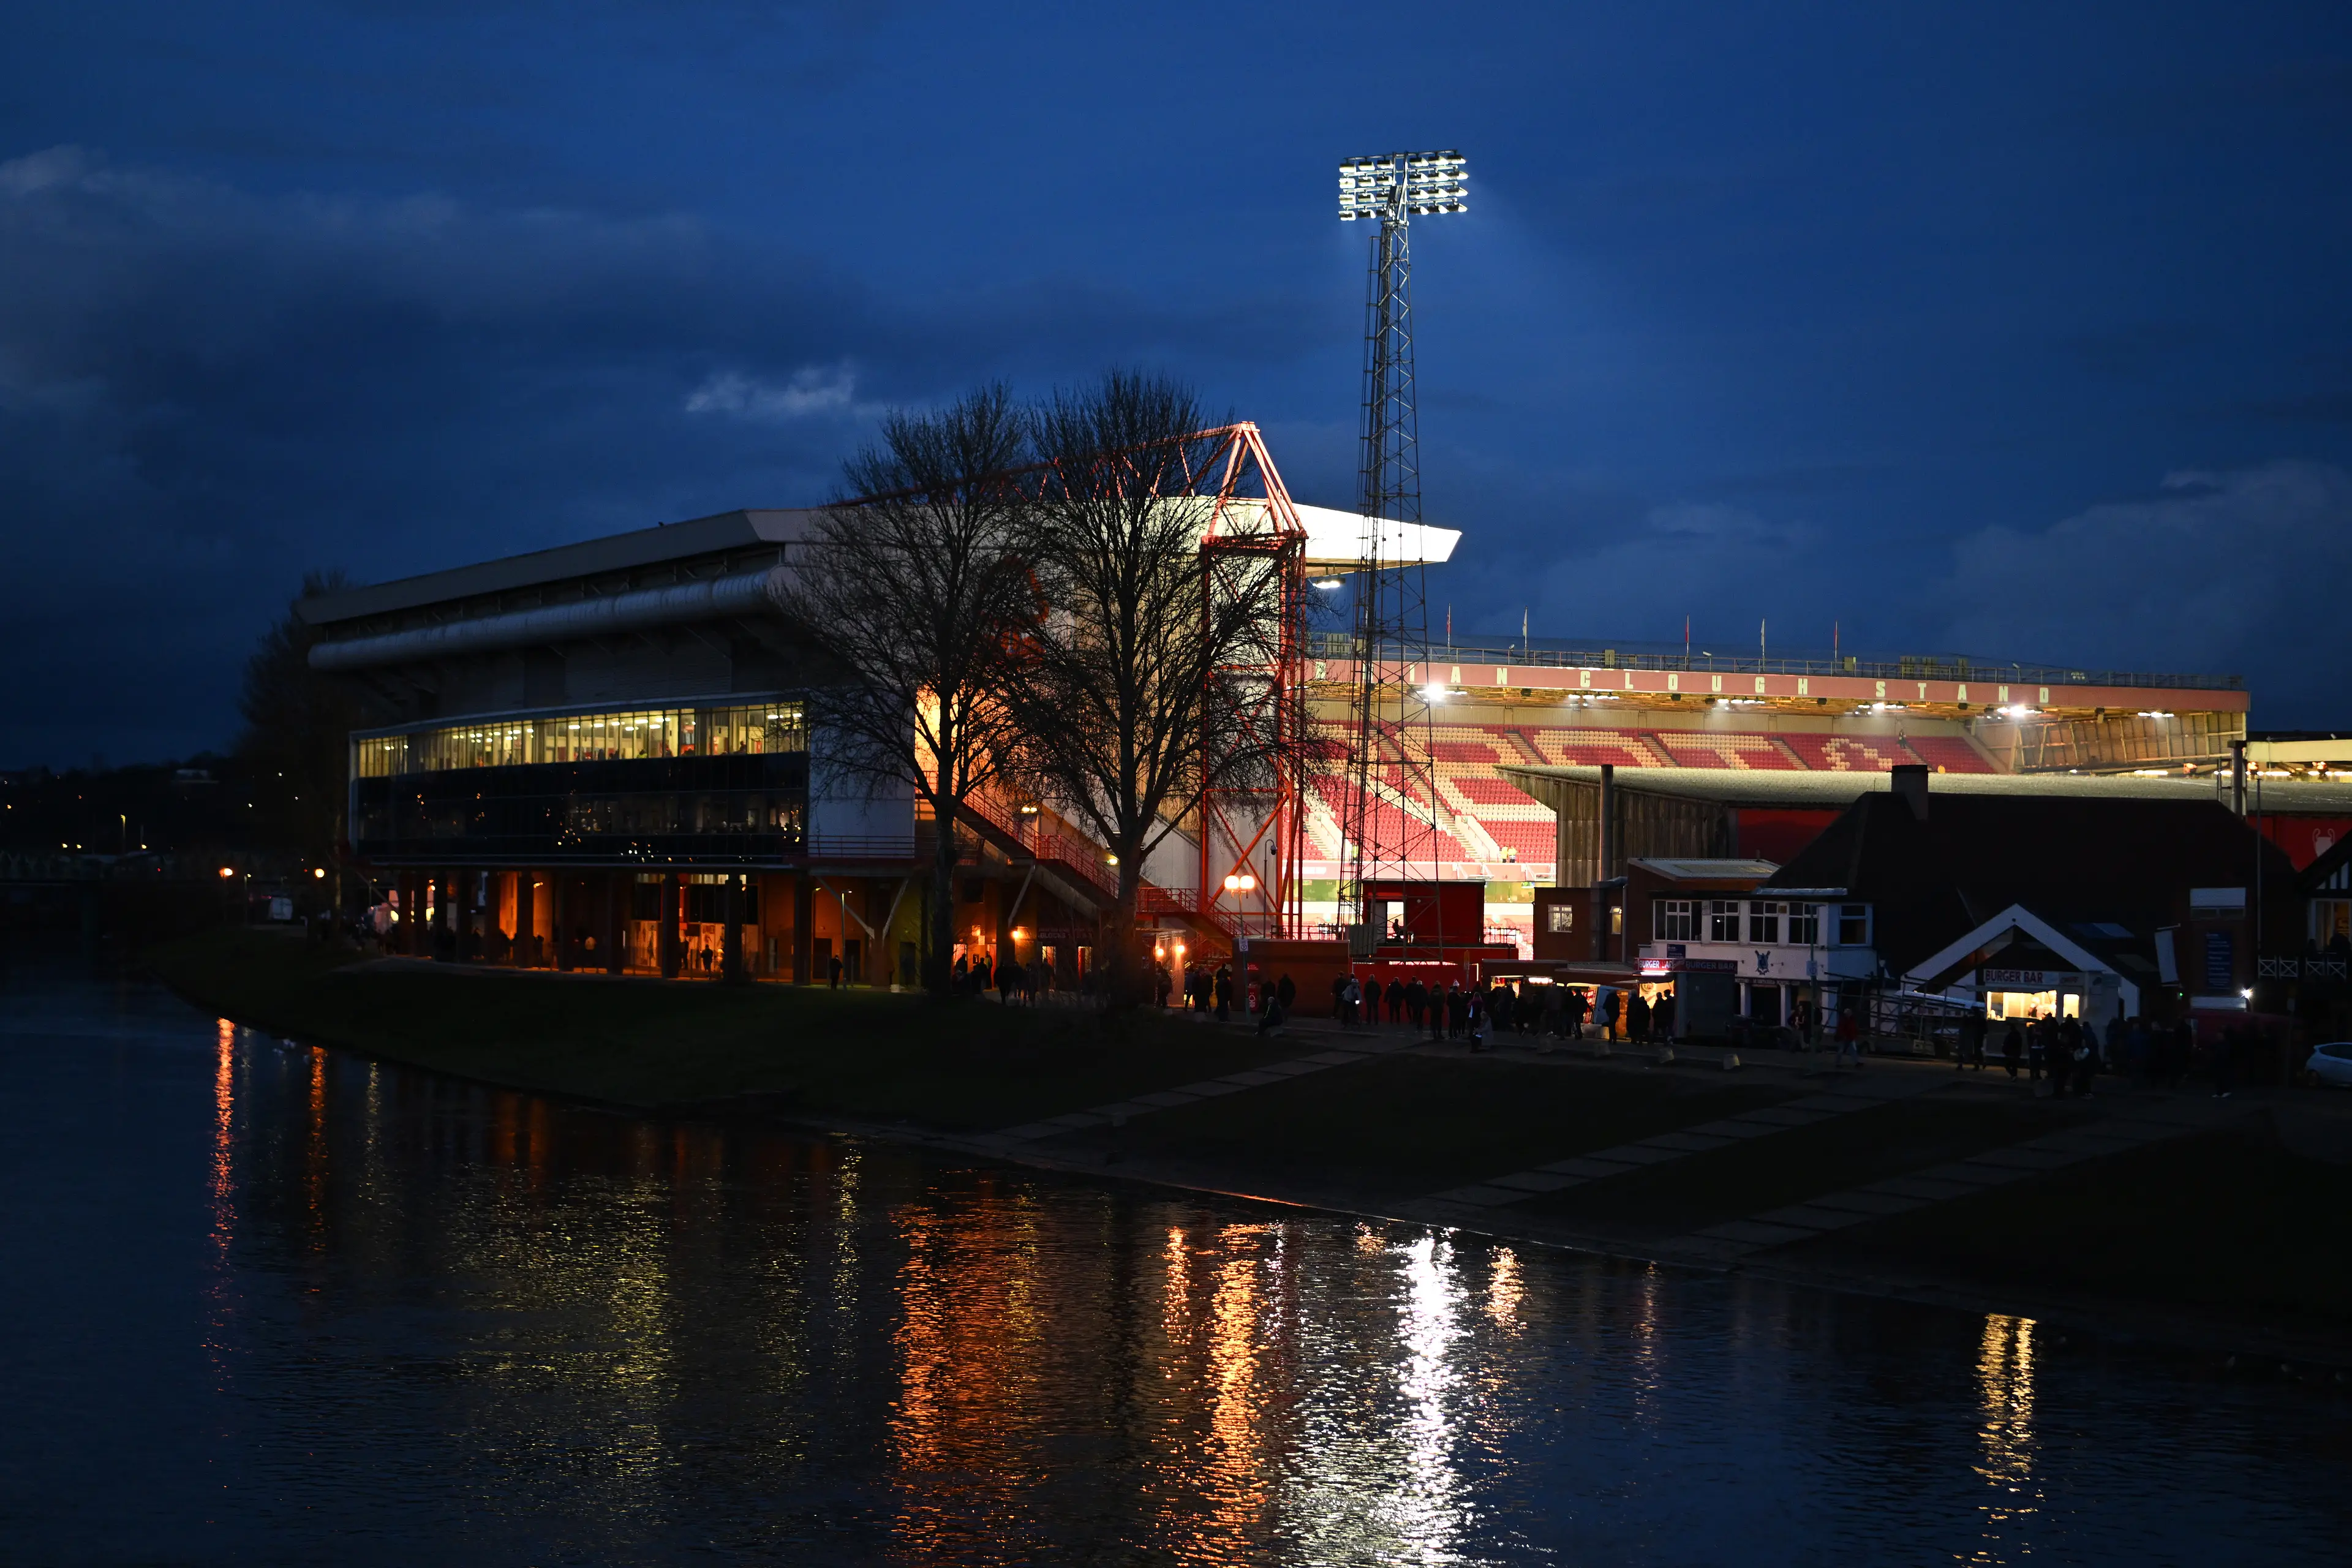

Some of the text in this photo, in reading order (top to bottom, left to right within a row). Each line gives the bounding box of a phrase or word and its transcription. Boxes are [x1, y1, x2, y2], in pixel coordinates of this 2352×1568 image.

[1580, 671, 1807, 695] CLOUGH
[1875, 681, 2049, 703] STAND
[1639, 960, 1660, 968] BURGER
[1686, 960, 1717, 970] BURGER
[1985, 970, 2043, 983] BURGER BAR
